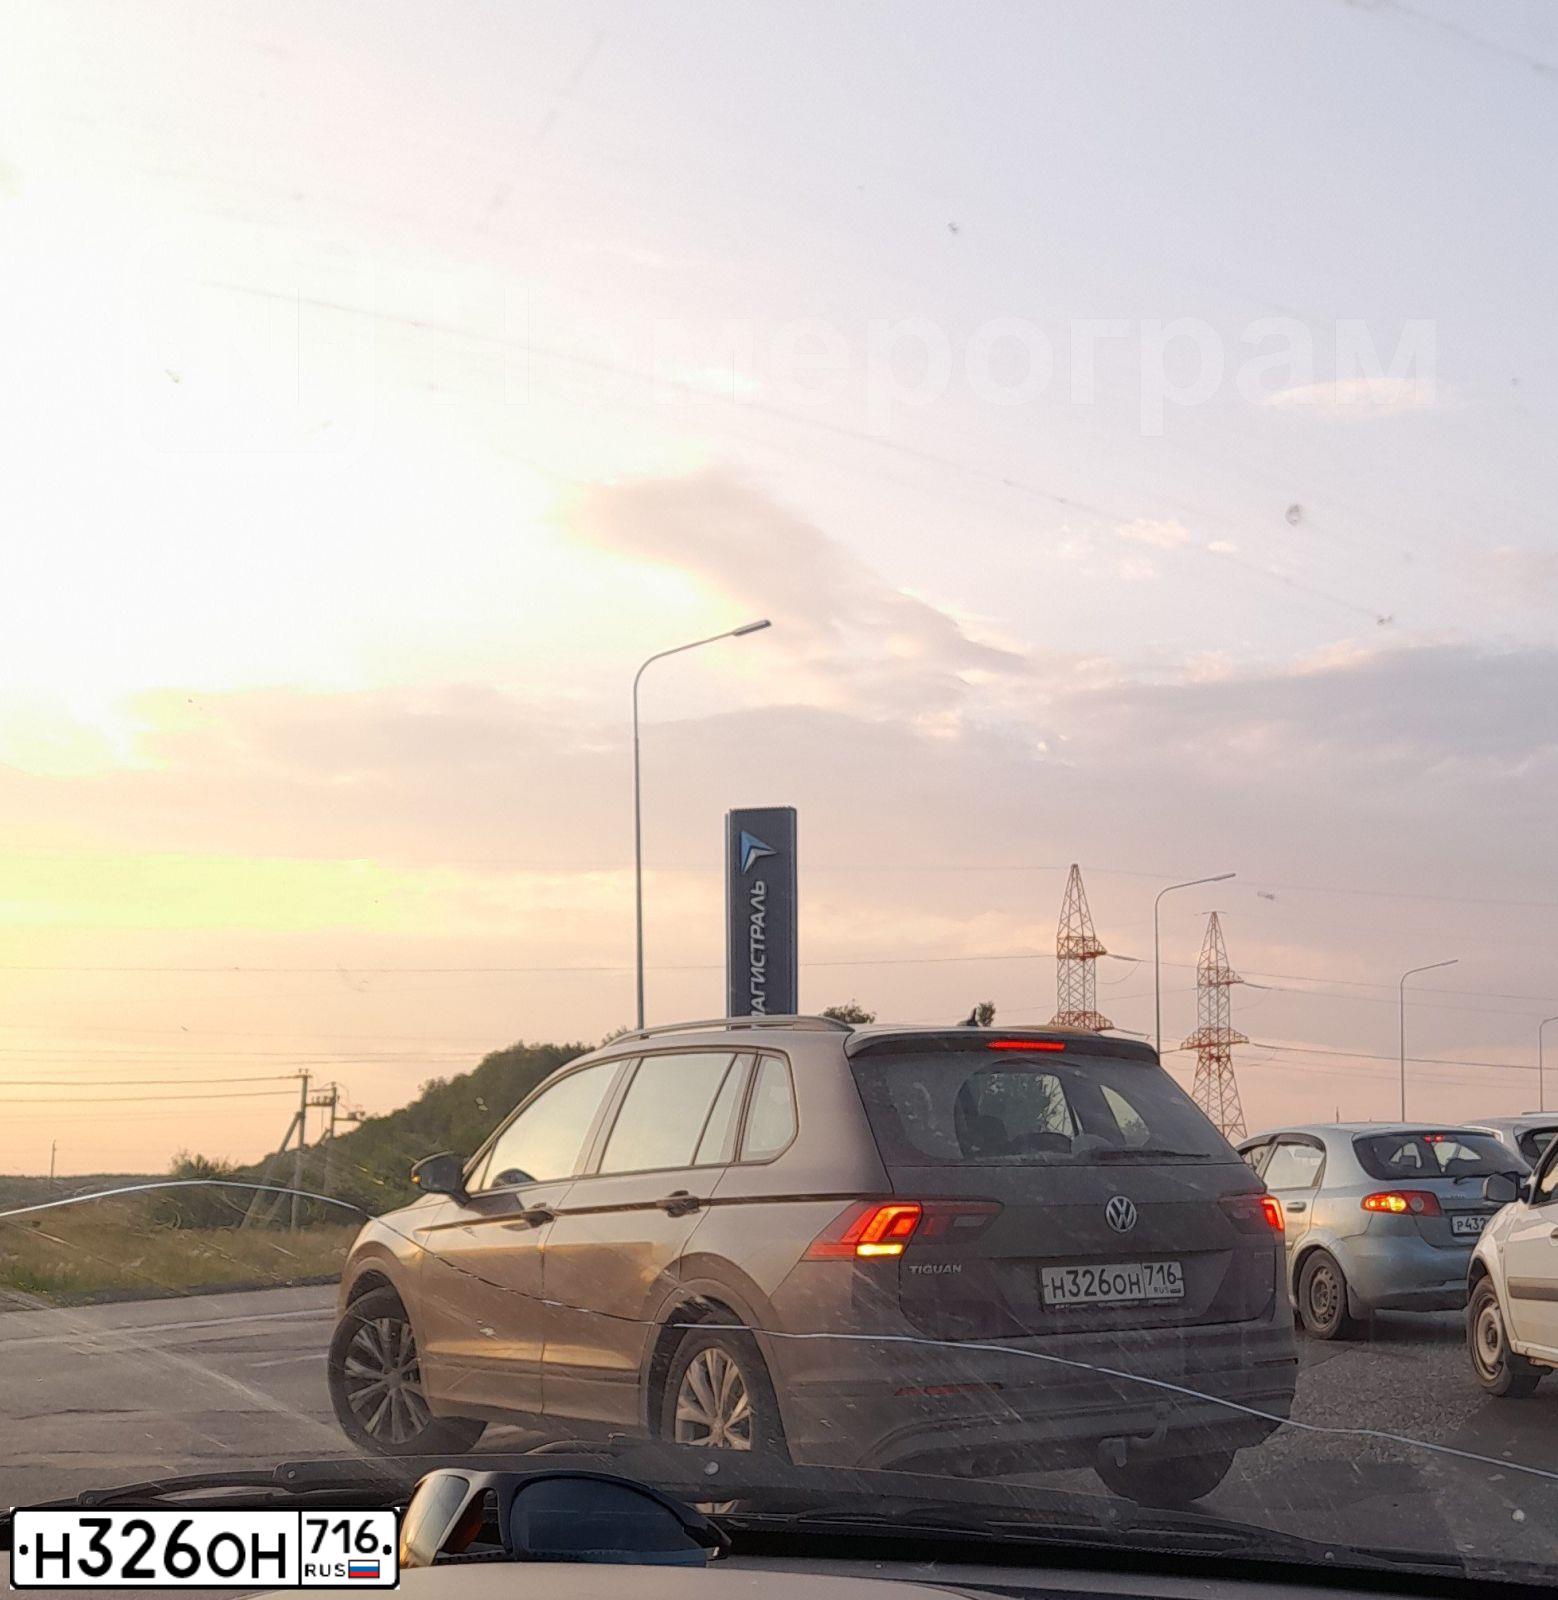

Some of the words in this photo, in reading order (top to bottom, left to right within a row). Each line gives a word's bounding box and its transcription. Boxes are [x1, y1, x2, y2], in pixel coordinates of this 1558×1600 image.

[908, 1263, 962, 1275] TIGUAN
[1051, 1267, 1142, 1299] Н326ОН
[1143, 1264, 1177, 1285] 716
